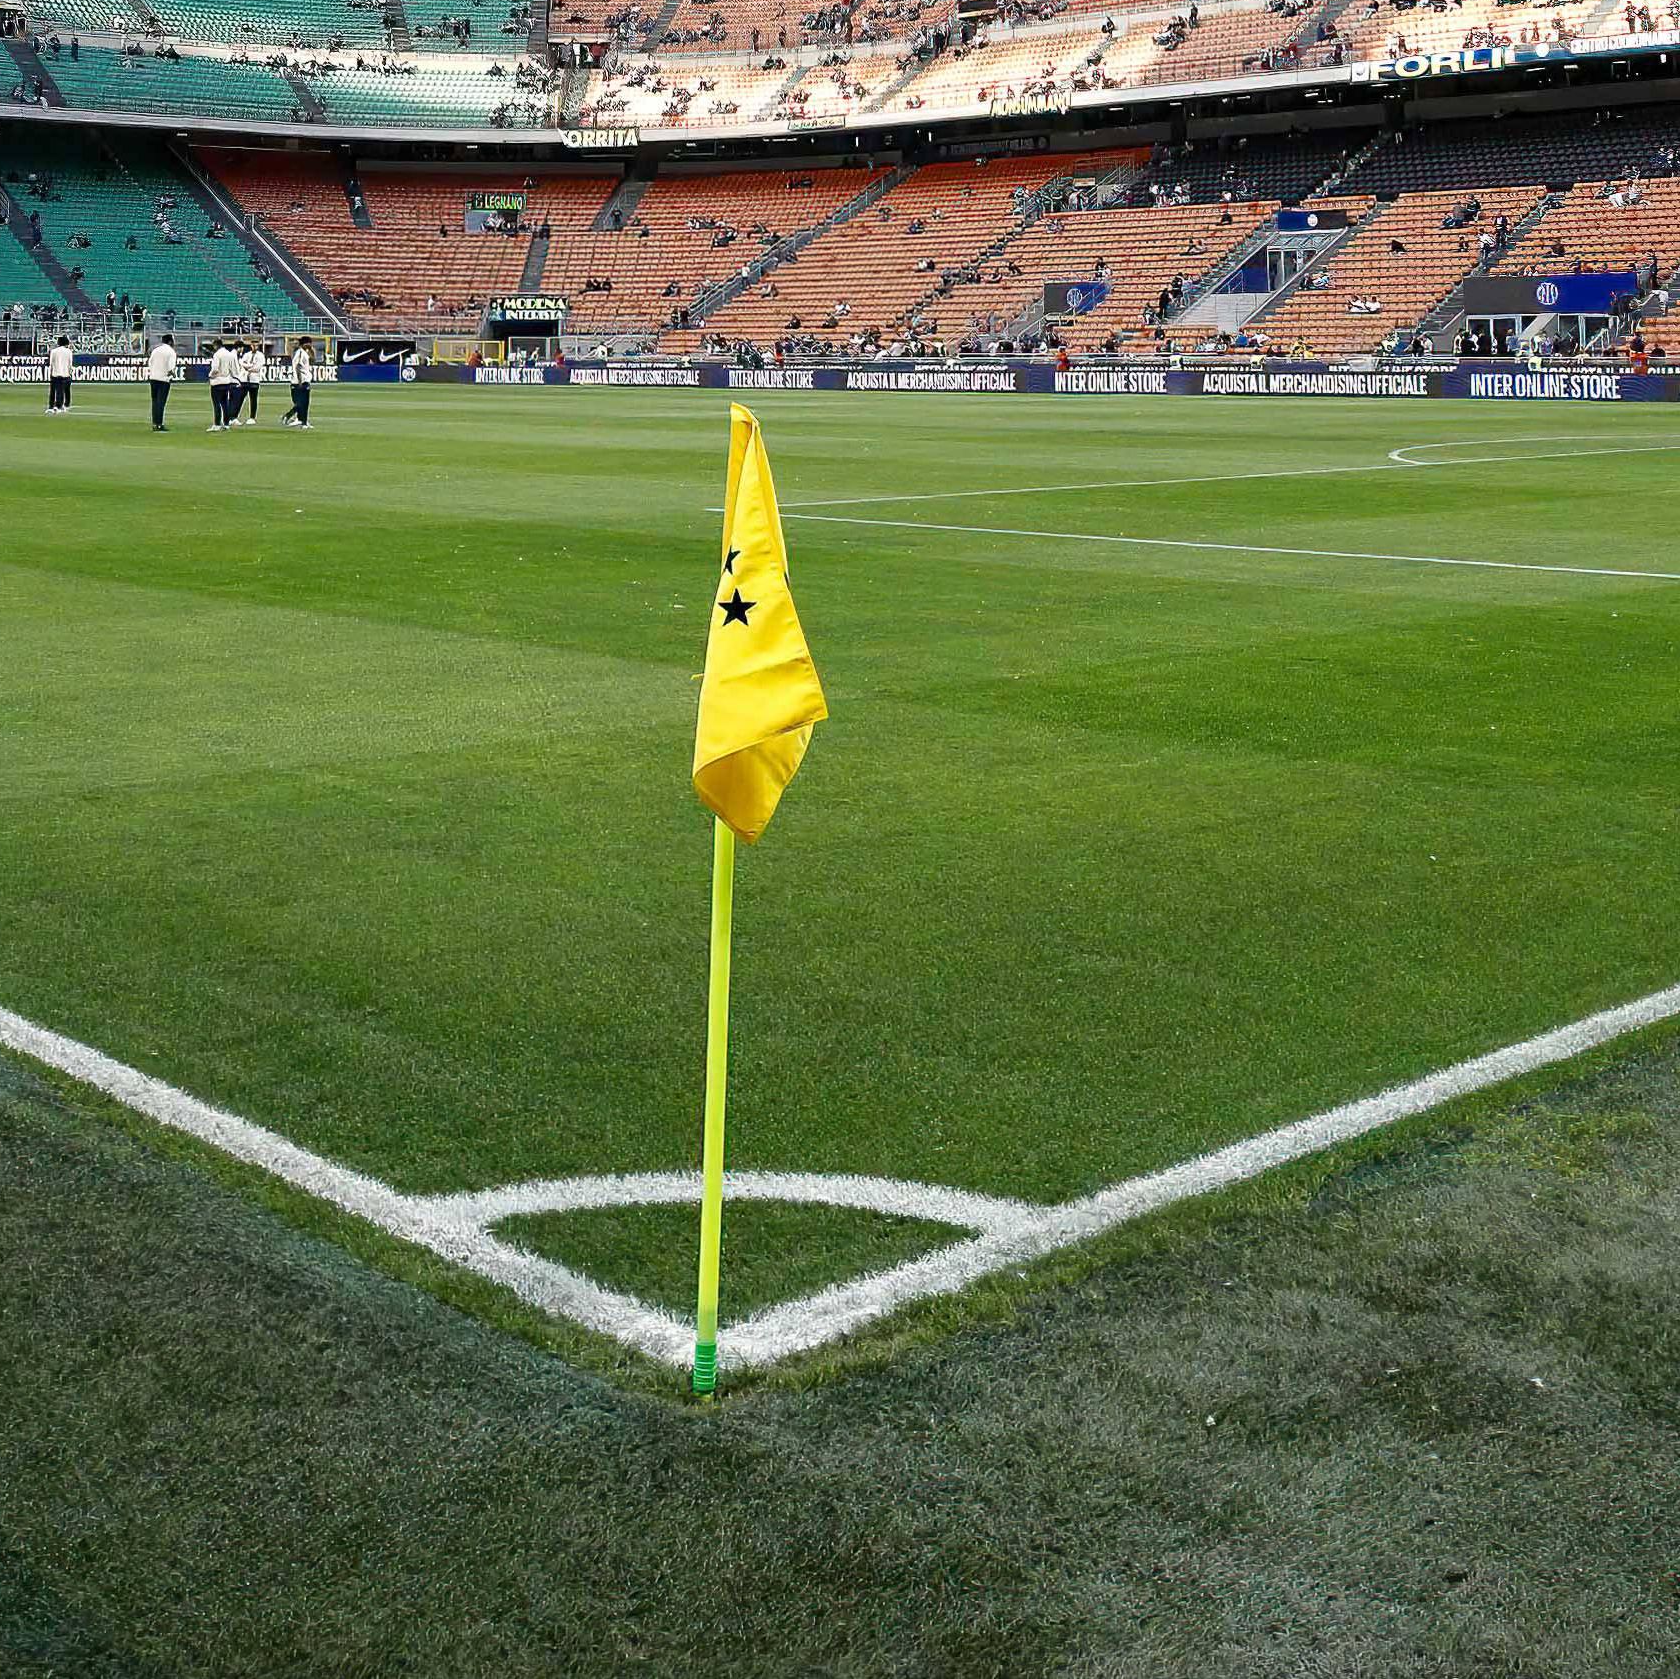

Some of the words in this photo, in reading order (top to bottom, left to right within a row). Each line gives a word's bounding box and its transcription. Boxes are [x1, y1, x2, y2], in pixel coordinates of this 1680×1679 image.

[503, 297, 566, 310] MODENA
[475, 368, 497, 384] INTER
[498, 368, 522, 384] ONLINE
[523, 368, 545, 384] STORE
[570, 369, 602, 385] ACQUISTA
[609, 369, 664, 385] MERCHANDISING
[665, 369, 700, 385] UFFICIALE
[729, 370, 754, 388] INTER
[754, 370, 785, 388] ONLINE
[786, 370, 814, 388] STORE
[847, 372, 888, 390] ACQUISTA
[889, 372, 897, 390] IL
[898, 372, 970, 390] MERCHANDISING
[971, 373, 1016, 390] UFFICIALE
[1055, 372, 1087, 392] INTER
[1087, 372, 1128, 392] ONLINE
[1128, 372, 1167, 393] STORE
[1203, 374, 1258, 394] ACQUISTA
[1258, 374, 1269, 393] IL
[1270, 374, 1366, 394] MERCHANDISING
[1367, 374, 1427, 395] UFFICIALE
[1471, 374, 1513, 396] INTER
[1515, 374, 1569, 398] ONLINE
[1570, 376, 1621, 399] STORE
